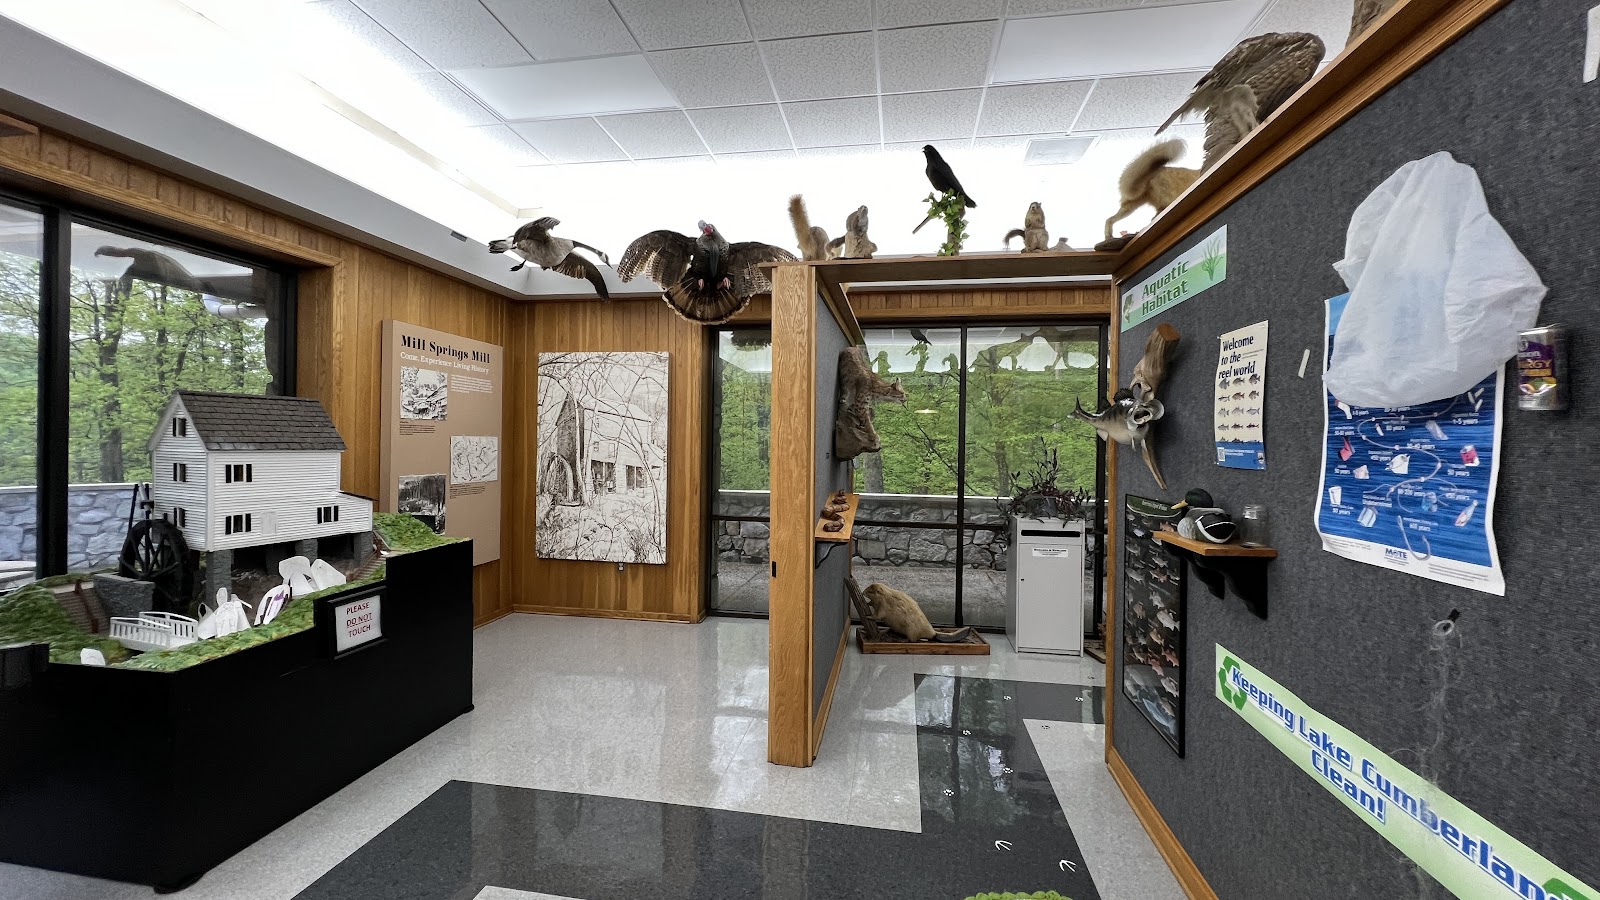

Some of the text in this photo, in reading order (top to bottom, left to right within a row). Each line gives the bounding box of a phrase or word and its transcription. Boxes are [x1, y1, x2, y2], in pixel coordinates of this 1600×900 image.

[1142, 260, 1189, 297] Aquatic
[1142, 280, 1189, 316] Habitat
[401, 335, 490, 363] Mill Springs Mill
[1222, 335, 1254, 352] Welcome
[400, 352, 490, 374] Come, Experience Living History
[1220, 352, 1229, 365] to
[1229, 351, 1242, 364] the
[1218, 361, 1256, 379] reel world
[1462, 418, 1479, 426] years
[1385, 547, 1408, 559] MOTE
[346, 602, 370, 615] PLEASE
[346, 612, 373, 627] DO NOT
[348, 624, 371, 638] TOUCH
[1232, 666, 1563, 900] Keeping Lake Cumberlan
[1311, 749, 1386, 824] Clean!
